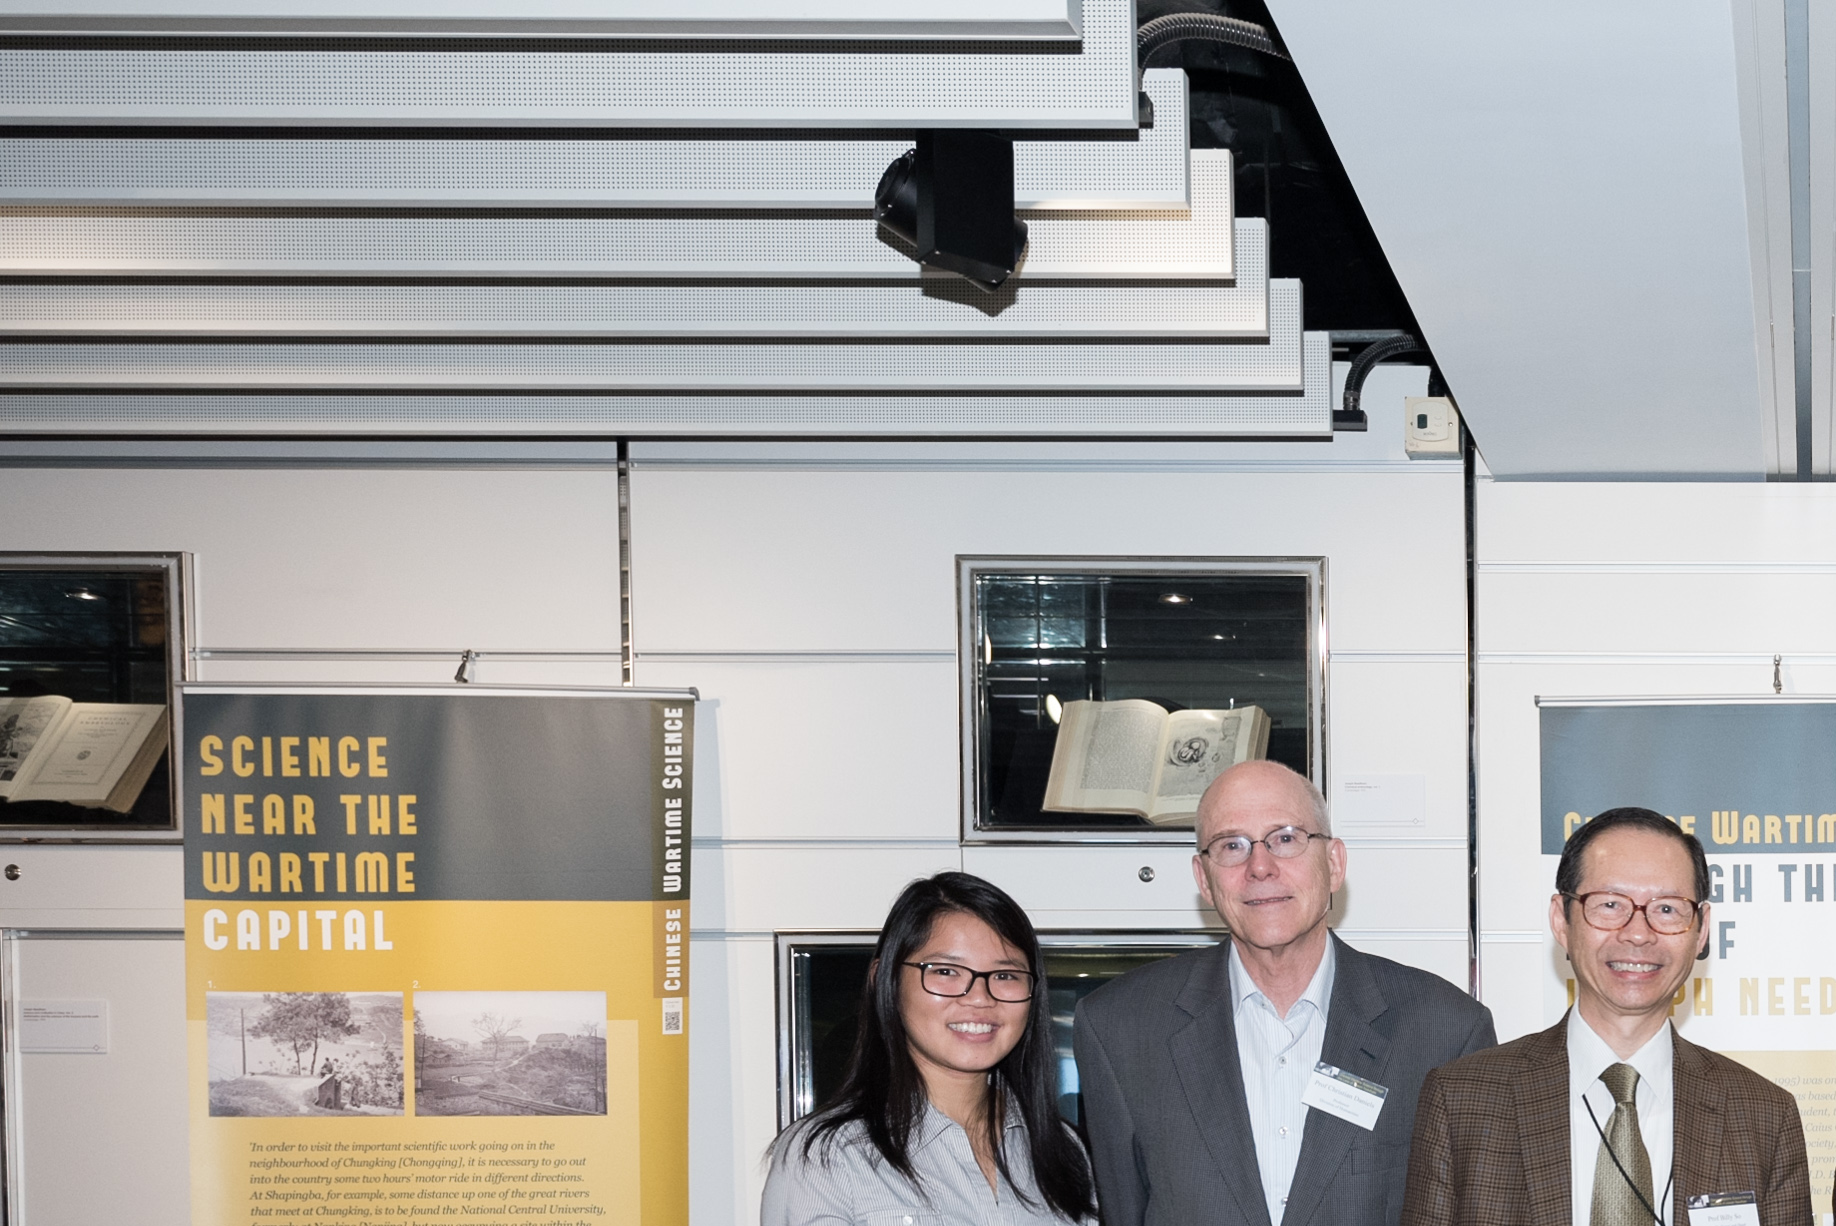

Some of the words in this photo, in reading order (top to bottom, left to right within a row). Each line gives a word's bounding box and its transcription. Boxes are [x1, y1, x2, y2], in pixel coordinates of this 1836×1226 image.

[200, 735, 388, 777] SCIENCE
[201, 794, 316, 834] NEAR
[340, 795, 417, 834] THE
[203, 852, 416, 893] WARTIME
[203, 909, 393, 950] CAPITAL
[1697, 921, 1736, 960] F
[1808, 1089, 1836, 1100] based
[1805, 1122, 1832, 1132] Caius
[250, 1142, 263, 1151] 'In
[265, 1142, 295, 1151] order
[298, 1143, 307, 1151] to
[310, 1142, 331, 1151] visit
[334, 1141, 349, 1150] the
[352, 1142, 400, 1153] important
[403, 1141, 446, 1152] scientific
[449, 1140, 476, 1150] work
[478, 1141, 508, 1152] going
[526, 1141, 536, 1149] in
[539, 1140, 554, 1149] the
[249, 1157, 328, 1169] neighbourhood
[331, 1157, 342, 1169] of
[344, 1158, 396, 1169] Chungking
[398, 1157, 466, 1169] [Chongqing],
[468, 1157, 474, 1165] it
[478, 1157, 485, 1165] is
[488, 1159, 538, 1168] necessary
[554, 1159, 566, 1167] go
[250, 1174, 271, 1183] into
[273, 1174, 289, 1183] the
[292, 1175, 331, 1185] country
[382, 1173, 413, 1182] hours'
[415, 1174, 446, 1182] motor
[449, 1172, 469, 1182] ride
[472, 1173, 481, 1181] in
[484, 1172, 528, 1184] different
[530, 1172, 583, 1181] directions.
